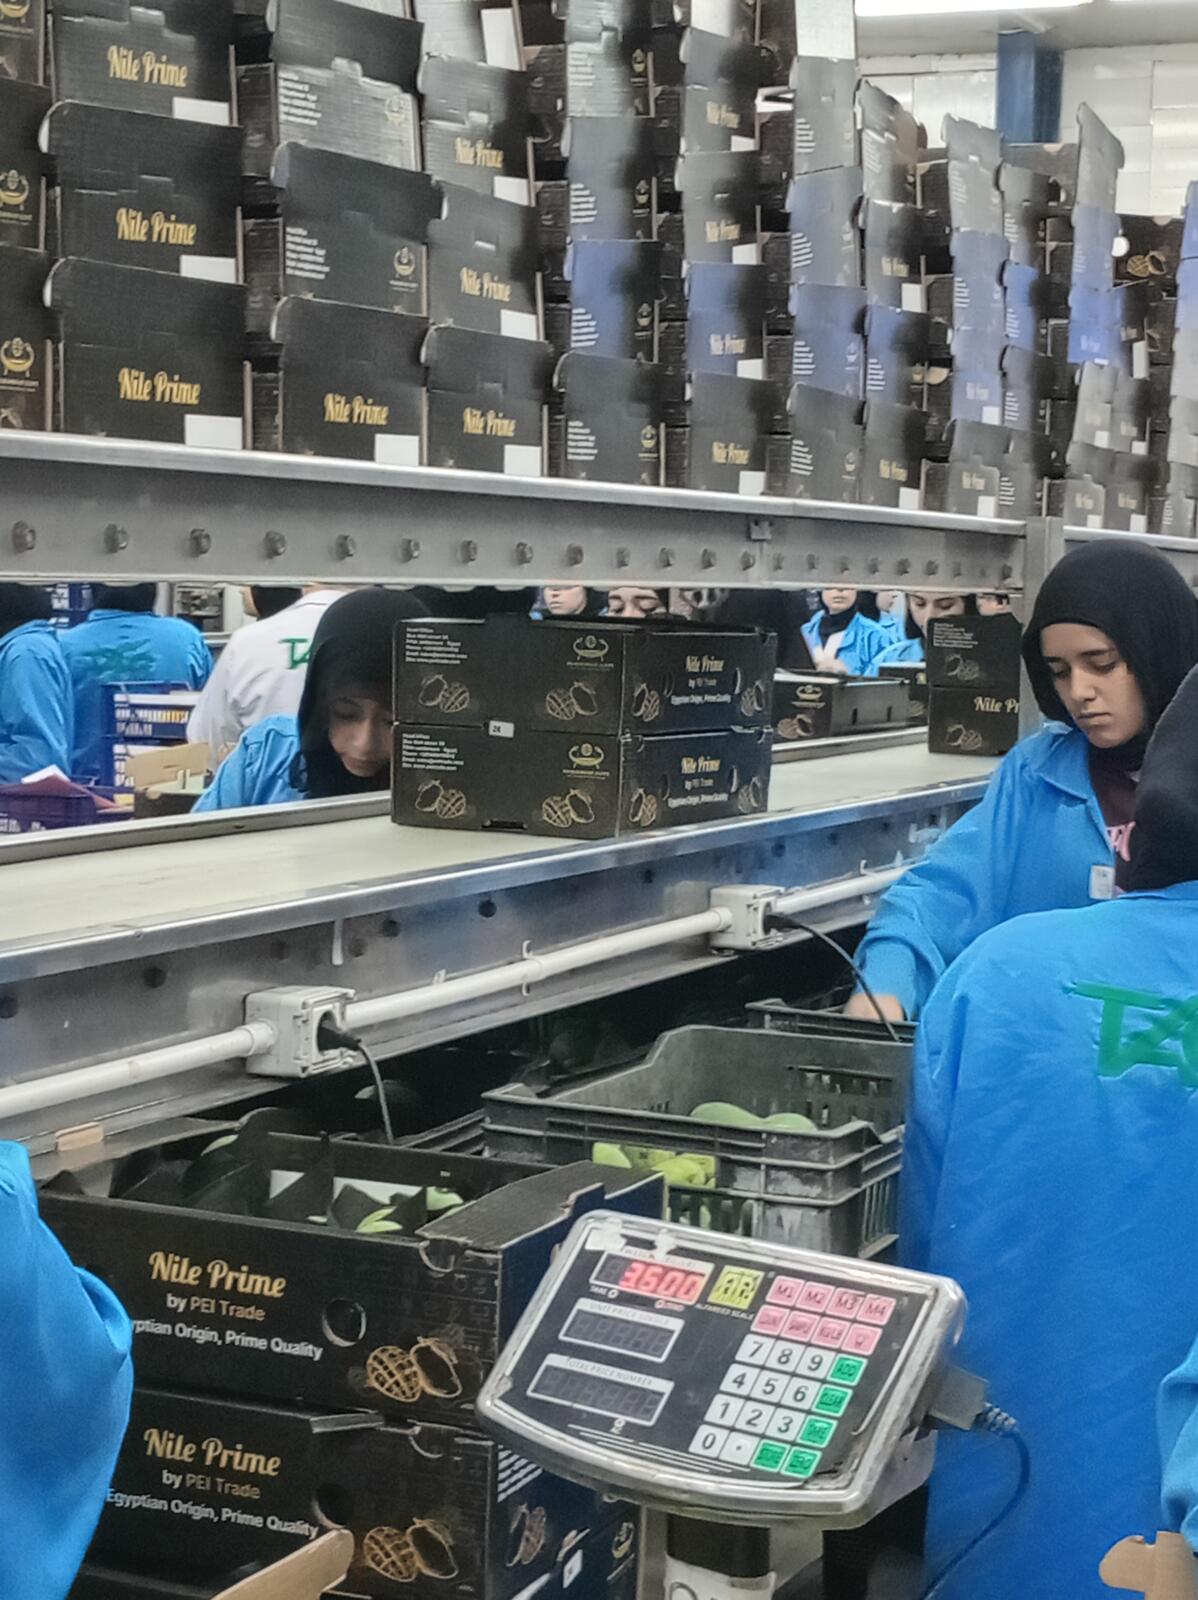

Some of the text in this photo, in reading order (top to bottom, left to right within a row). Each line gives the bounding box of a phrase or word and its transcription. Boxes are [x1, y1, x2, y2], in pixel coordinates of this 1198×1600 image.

[107, 45, 188, 88] Nile Prime
[116, 207, 197, 246] Nile Prime
[118, 368, 200, 405] Nile Prime
[324, 393, 389, 426] Nile Prime
[974, 696, 1003, 712] Nile
[149, 1250, 287, 1299] Nile Prime
[619, 1261, 704, 1300] 3600
[166, 1293, 266, 1321] by PEI Trade
[777, 1285, 794, 1299] M1
[806, 1290, 825, 1305] M2
[836, 1295, 857, 1310] M3
[174, 1323, 223, 1345] Origin,
[225, 1331, 268, 1350] Prime
[270, 1337, 324, 1361] Quality
[748, 1341, 763, 1357] 7
[777, 1348, 793, 1366] 8
[807, 1354, 823, 1372] 9
[732, 1372, 747, 1390] 4
[762, 1377, 779, 1396] 5
[793, 1386, 809, 1403] 6
[720, 1401, 730, 1419] 1
[745, 1408, 763, 1427] 2
[777, 1416, 793, 1434] 3
[143, 1428, 282, 1477] Nile Prime
[702, 1433, 717, 1450] 0
[162, 1470, 262, 1499] by PEI Trade
[171, 1500, 219, 1523] Origin,
[221, 1508, 263, 1528] Prime
[265, 1515, 320, 1540] Quality
